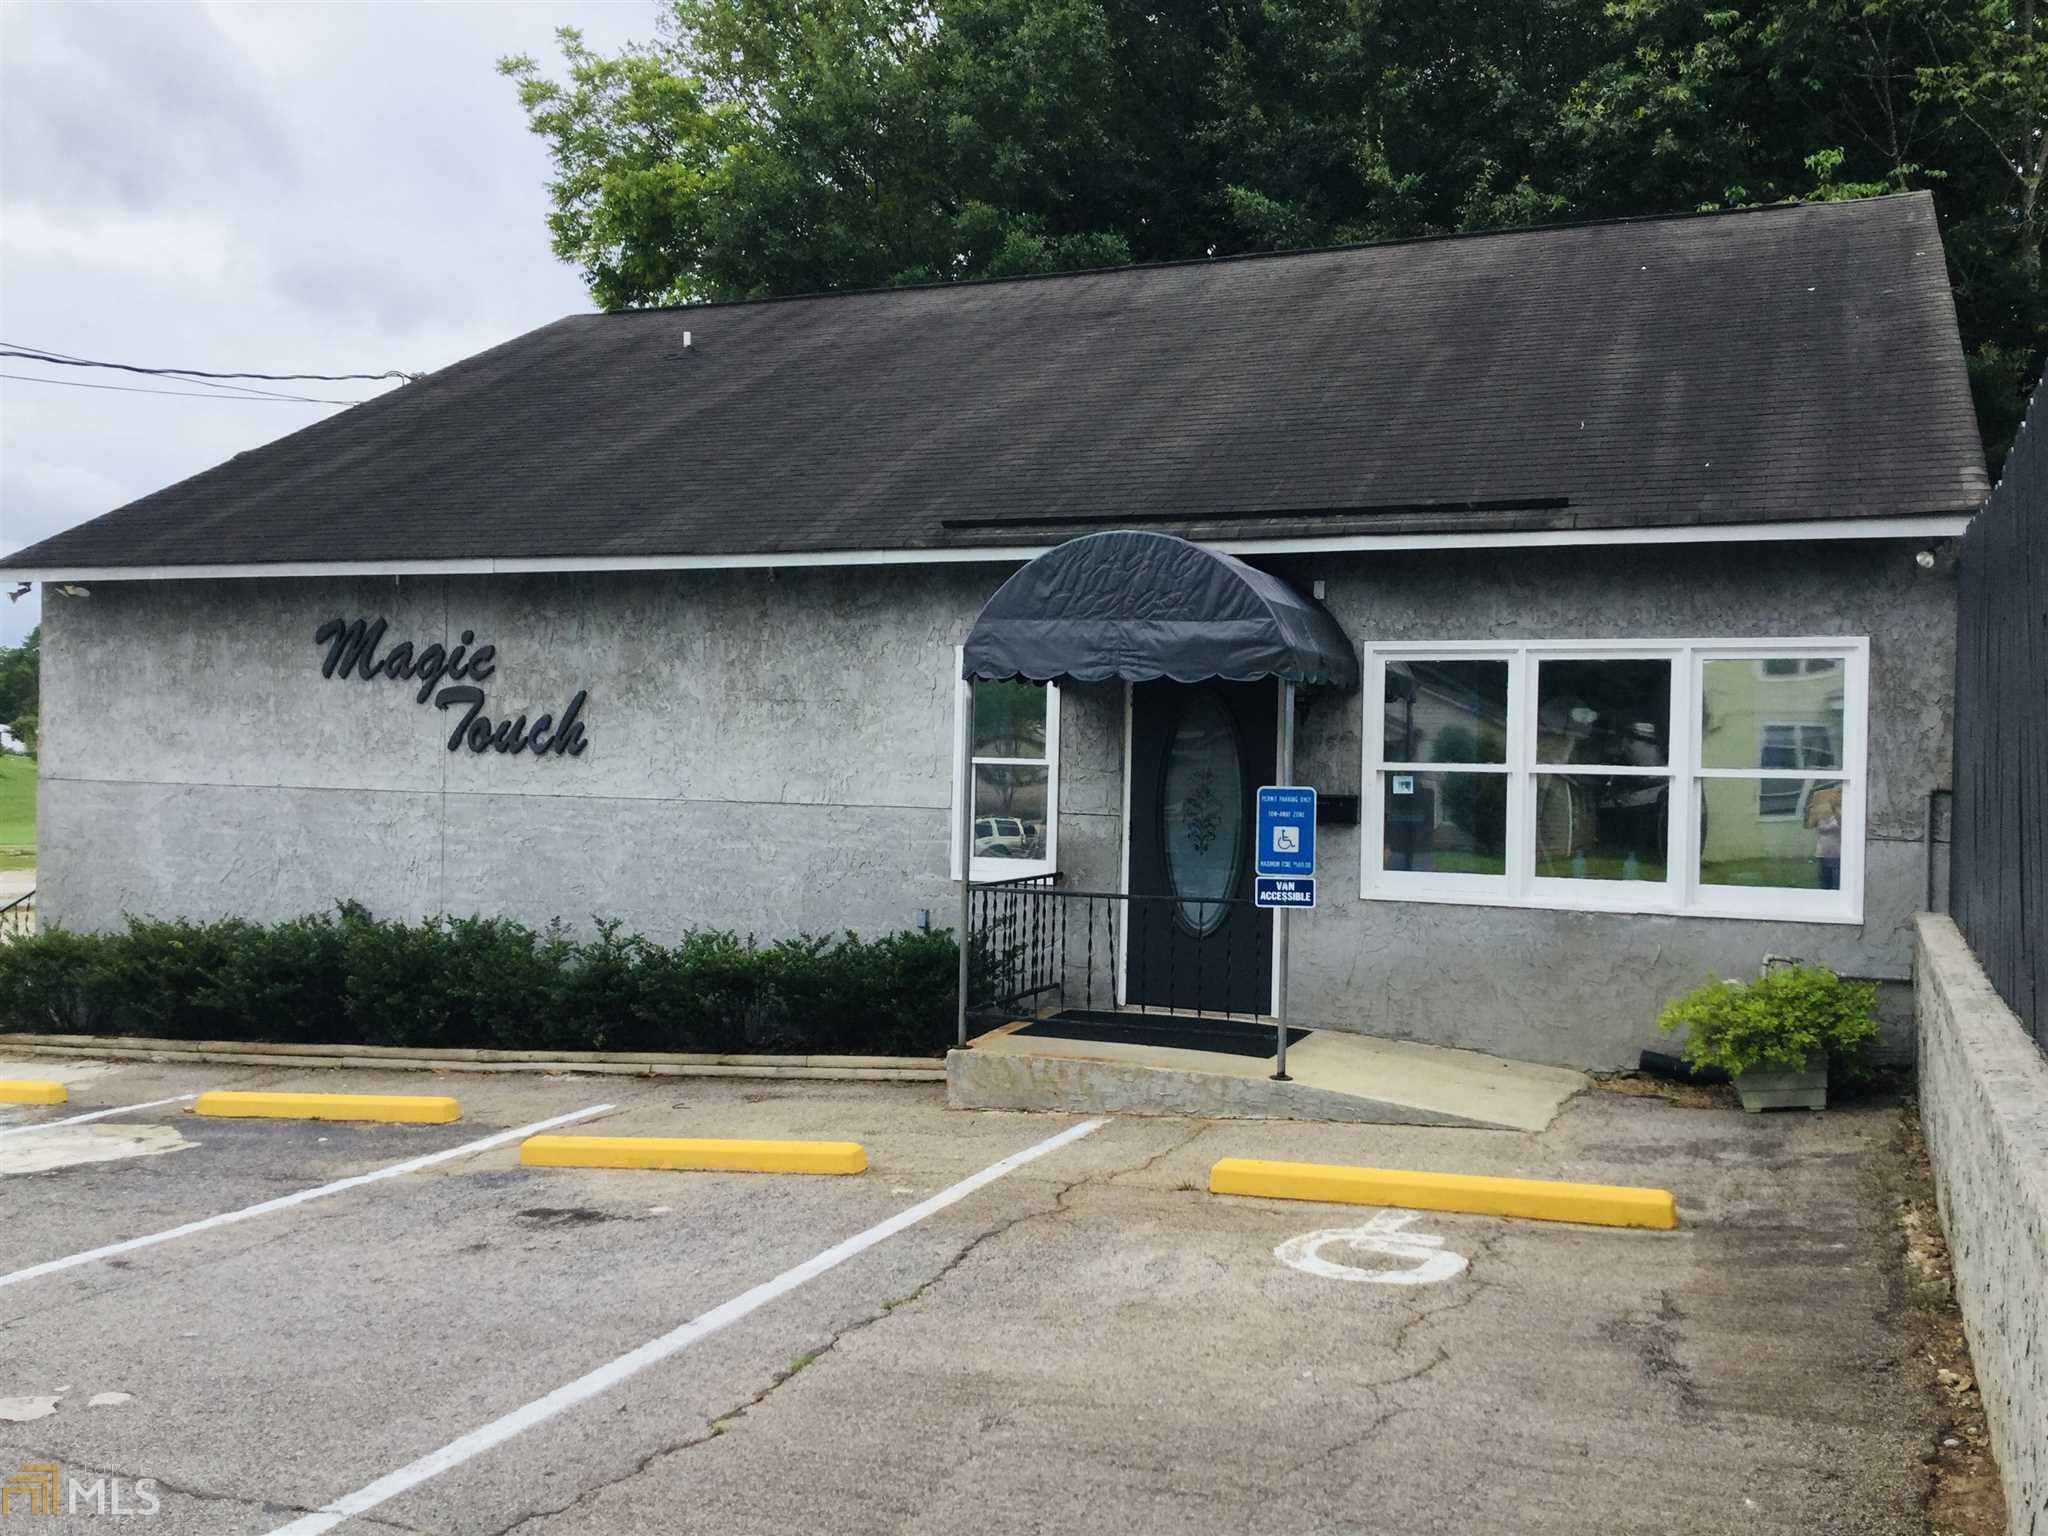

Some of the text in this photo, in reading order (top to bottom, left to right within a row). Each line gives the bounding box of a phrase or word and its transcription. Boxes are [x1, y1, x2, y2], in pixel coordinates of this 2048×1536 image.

[315, 616, 496, 704] Magic
[435, 685, 588, 756] Touch
[1260, 891, 1312, 902] ACCESSIBLE
[1276, 881, 1296, 891] VAN
